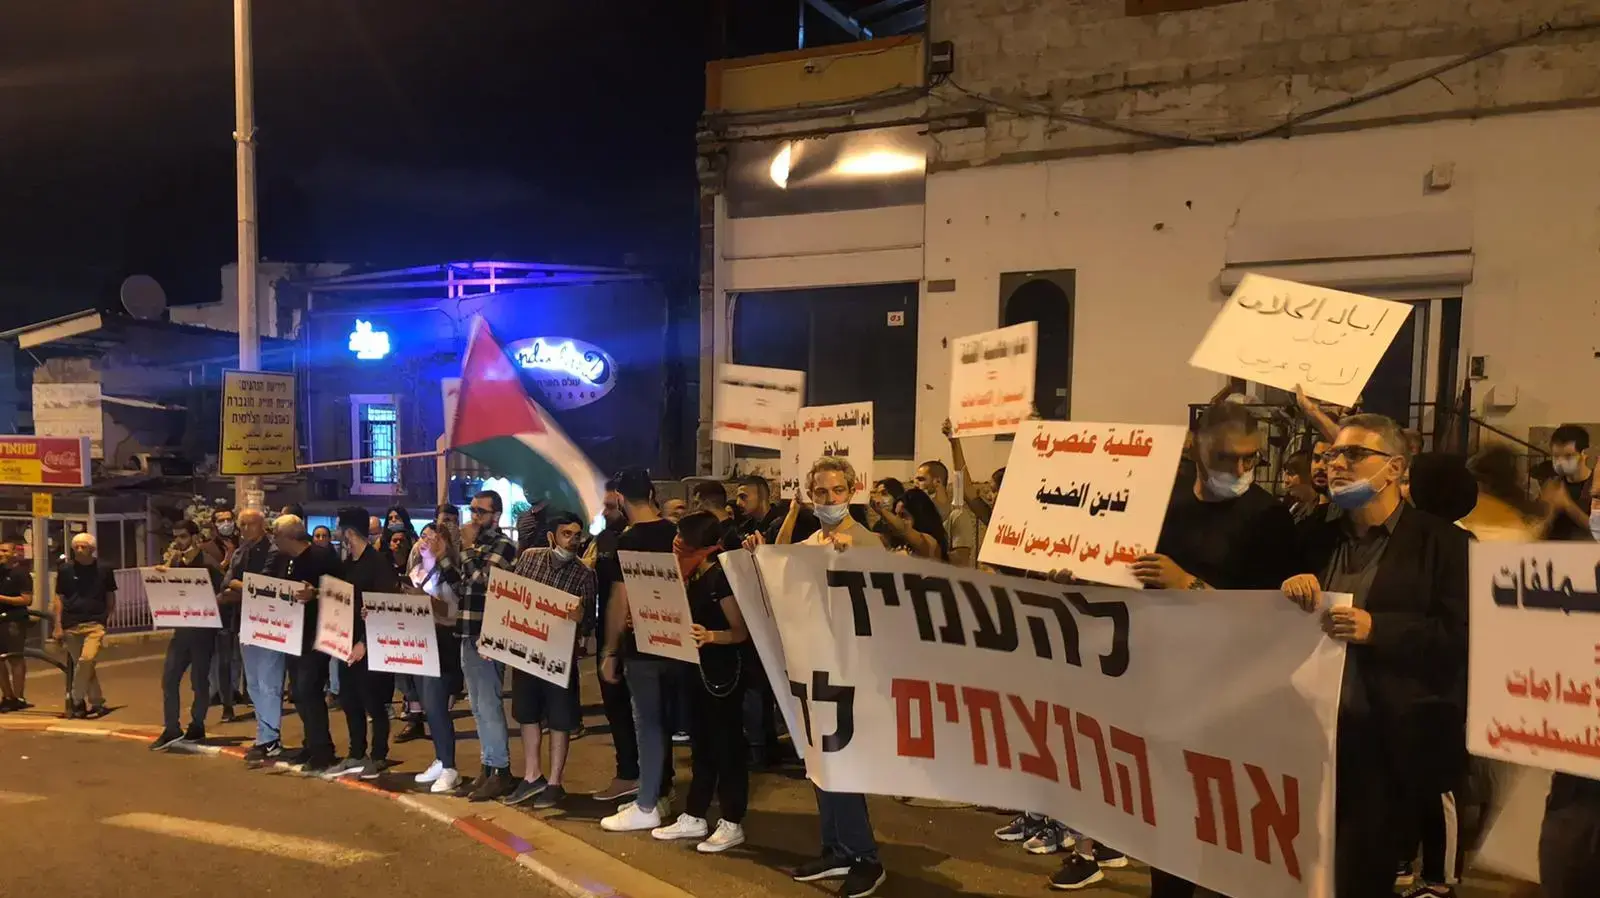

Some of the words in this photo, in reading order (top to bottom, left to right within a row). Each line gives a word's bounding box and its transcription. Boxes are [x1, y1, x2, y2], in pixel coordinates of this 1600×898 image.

[1032, 425, 1097, 457] عنصرية
[1103, 428, 1153, 462] عقلية
[1036, 478, 1090, 510] الضحية
[1024, 533, 1079, 556] المجرمين
[1079, 538, 1100, 562] من
[1104, 540, 1148, 566] تجعل
[490, 578, 532, 610] والخلود
[501, 609, 550, 642] للشهداء
[827, 569, 1131, 678] להעמיד
[892, 678, 1157, 827] הרוצחים
[1183, 749, 1302, 882] את
